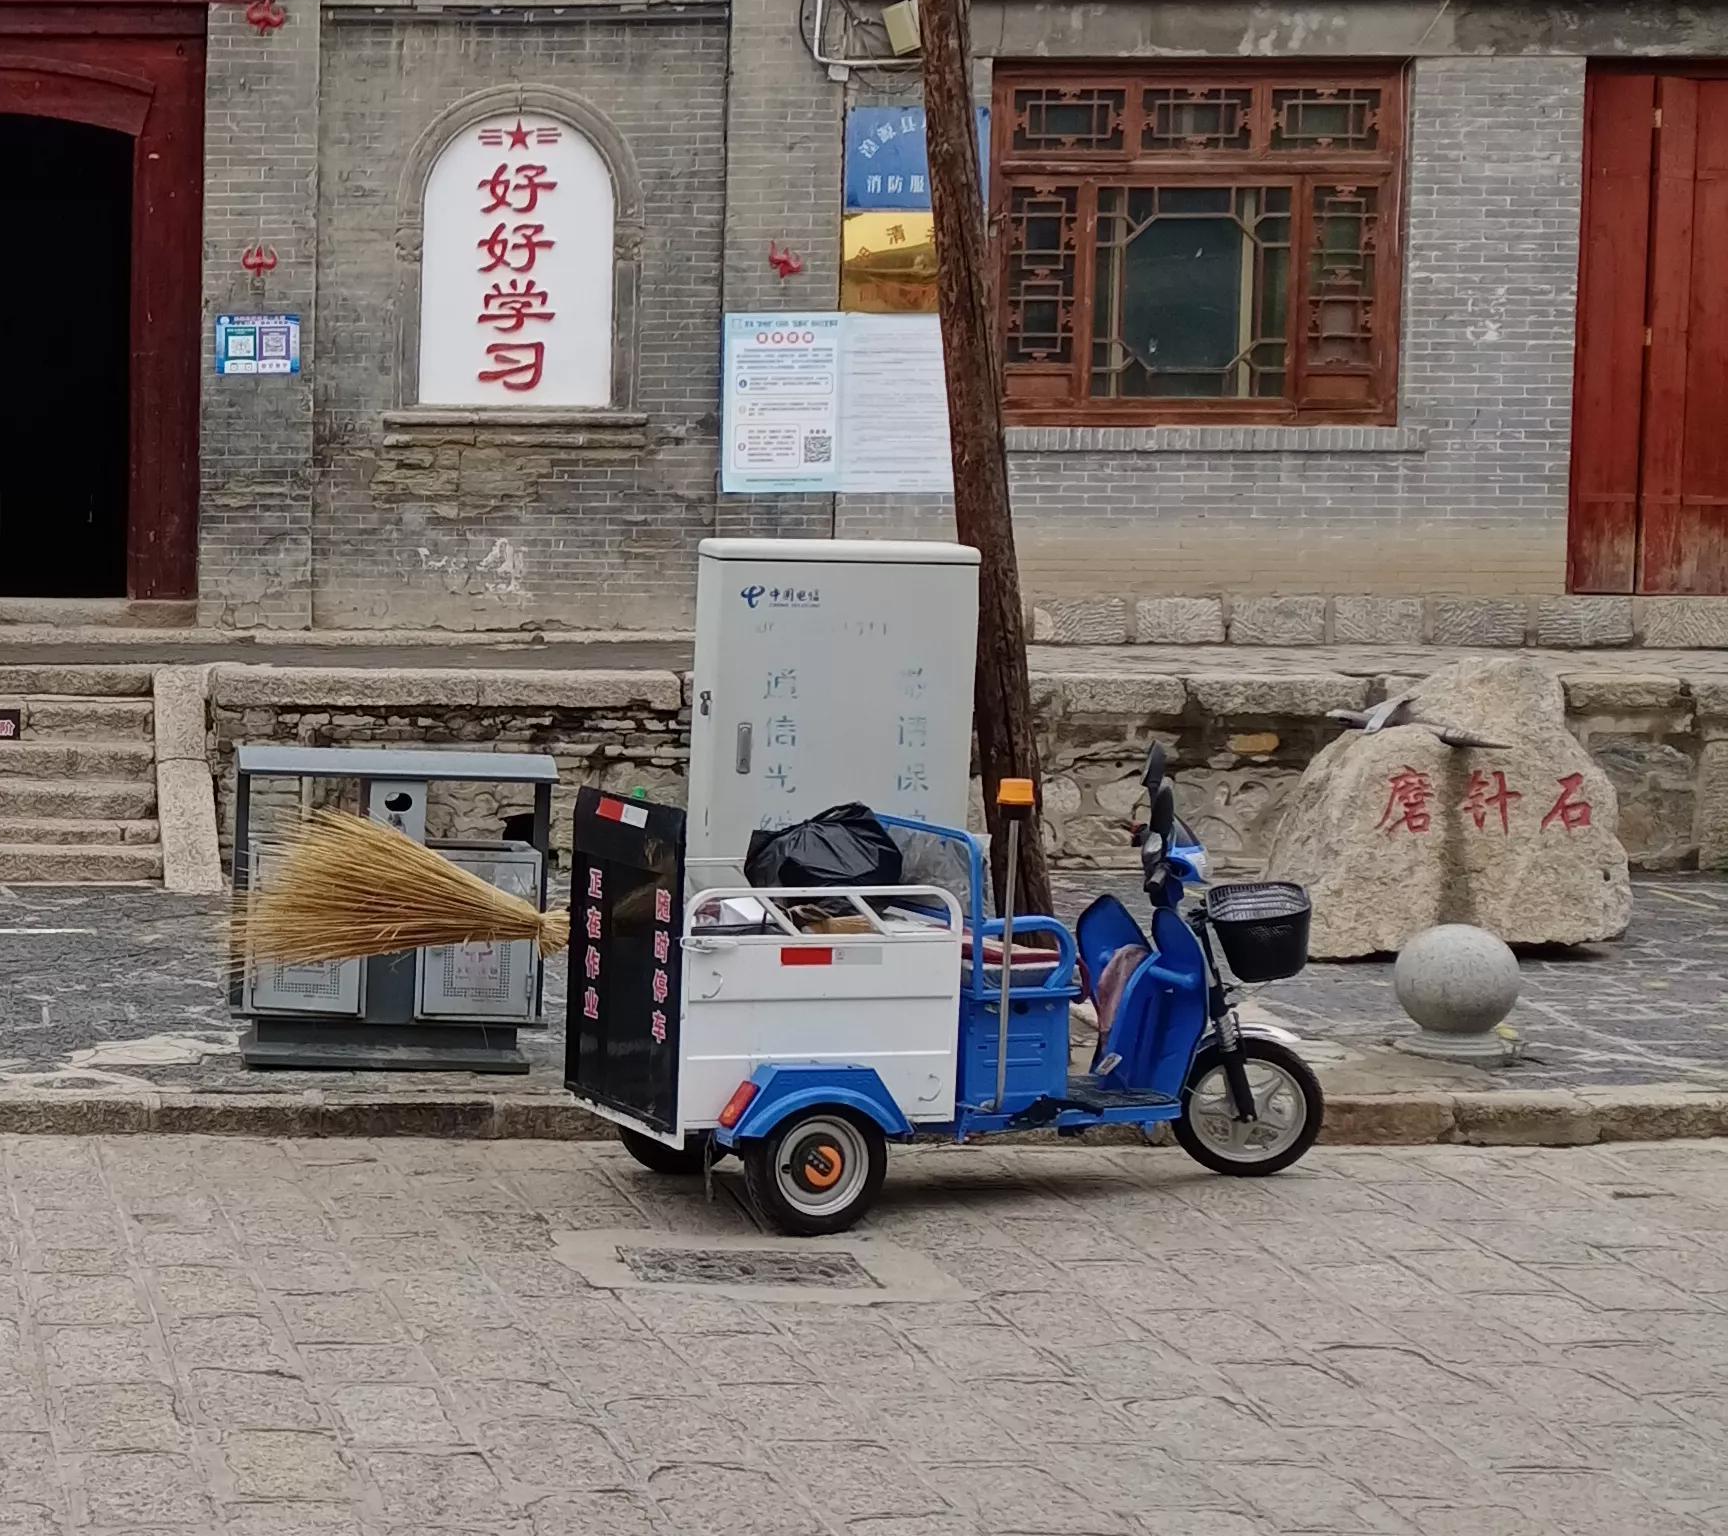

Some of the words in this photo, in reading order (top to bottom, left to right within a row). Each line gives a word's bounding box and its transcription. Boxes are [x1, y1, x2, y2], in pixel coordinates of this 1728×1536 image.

[857, 115, 926, 158] 湟源县
[477, 162, 558, 392] 好好学习
[1375, 764, 1593, 836] 磨针石
[583, 867, 603, 1020] 正在作业
[652, 888, 672, 1044] 随时停车
